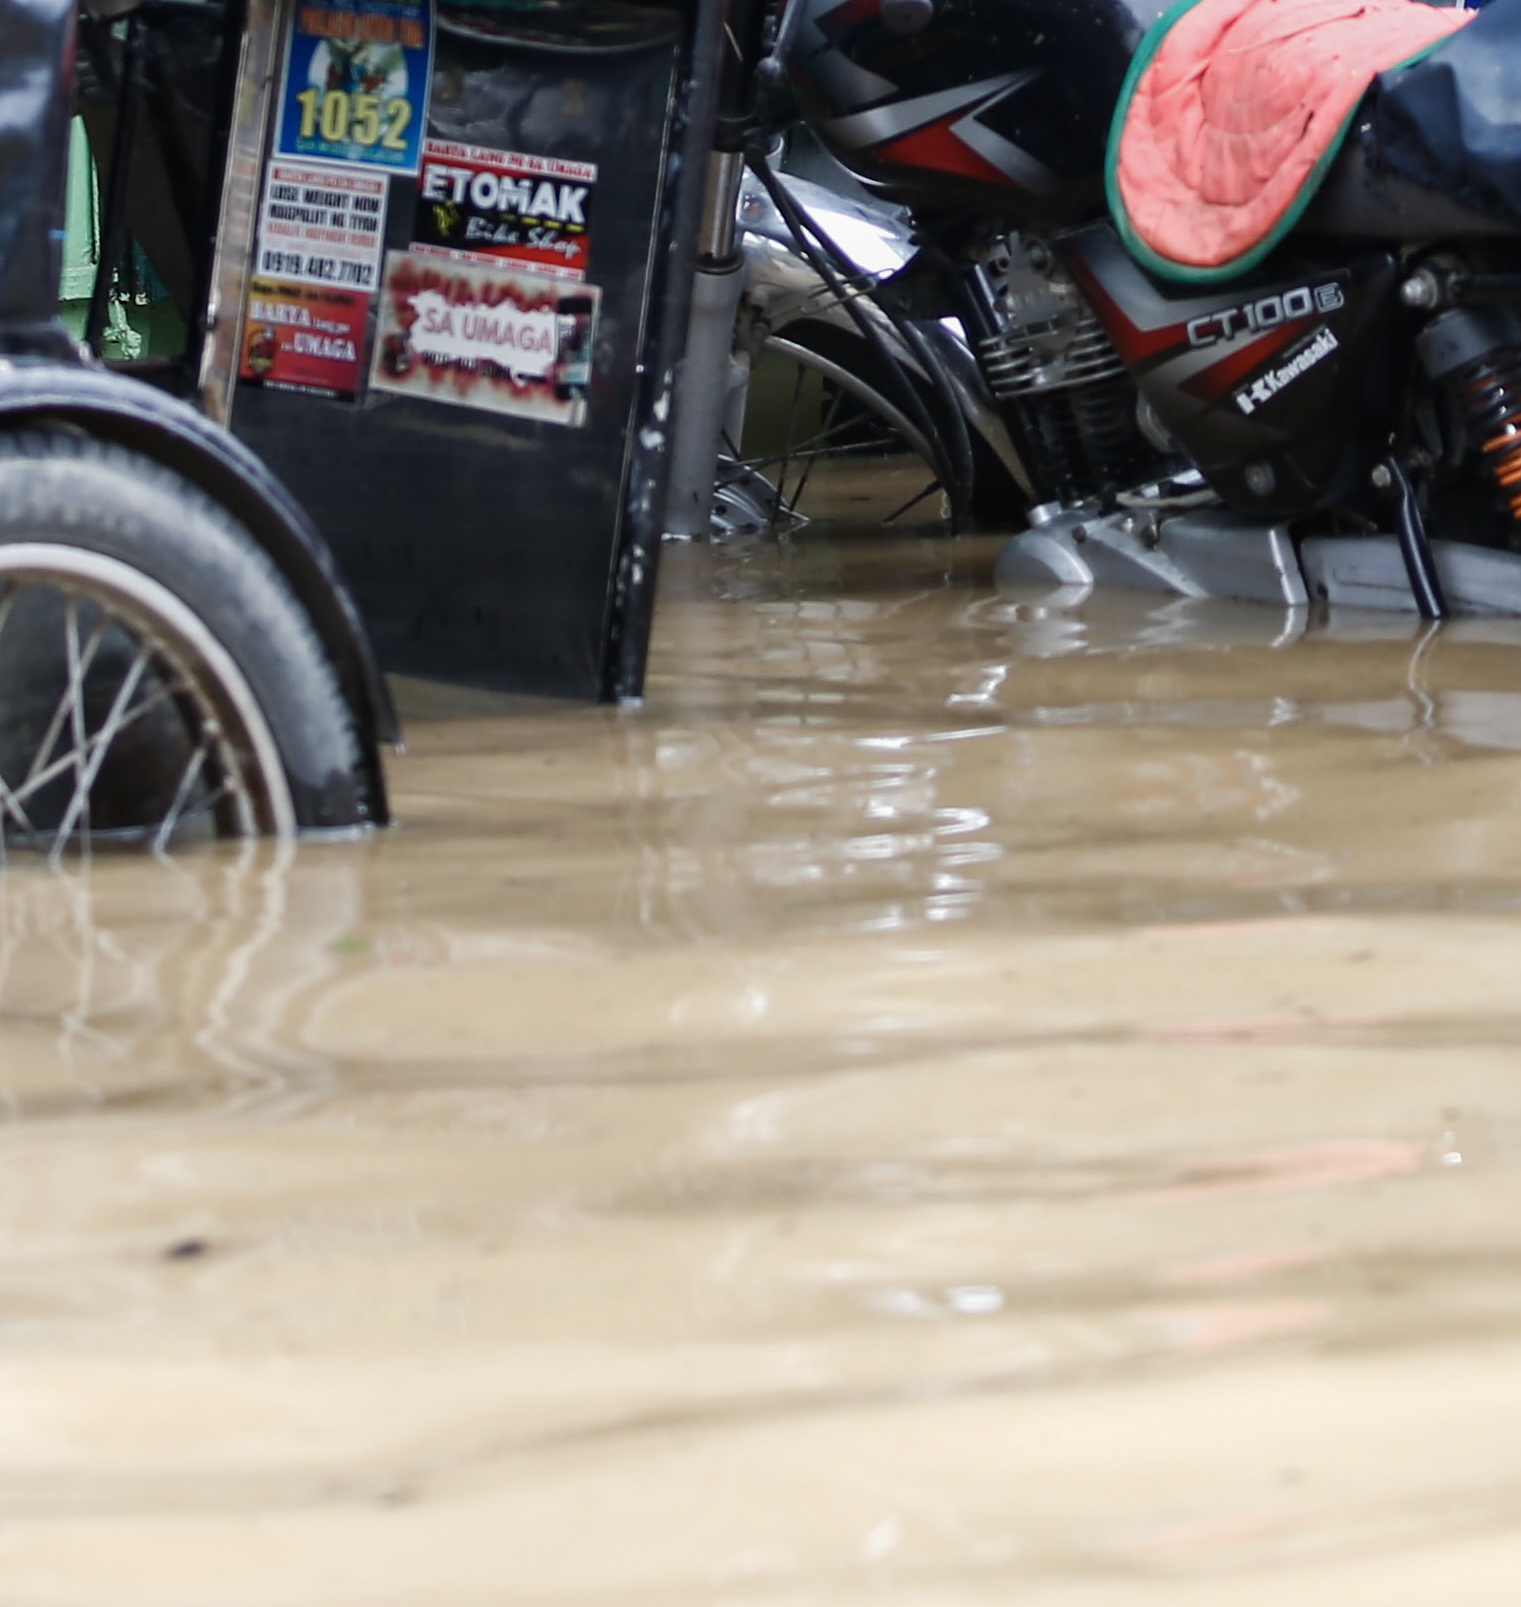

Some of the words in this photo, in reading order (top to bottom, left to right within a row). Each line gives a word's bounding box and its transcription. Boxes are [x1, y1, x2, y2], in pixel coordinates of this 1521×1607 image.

[296, 87, 413, 151] 1052
[423, 308, 454, 338] SA
[462, 313, 553, 355] UMAGA
[1264, 327, 1339, 392] Kawasaki
